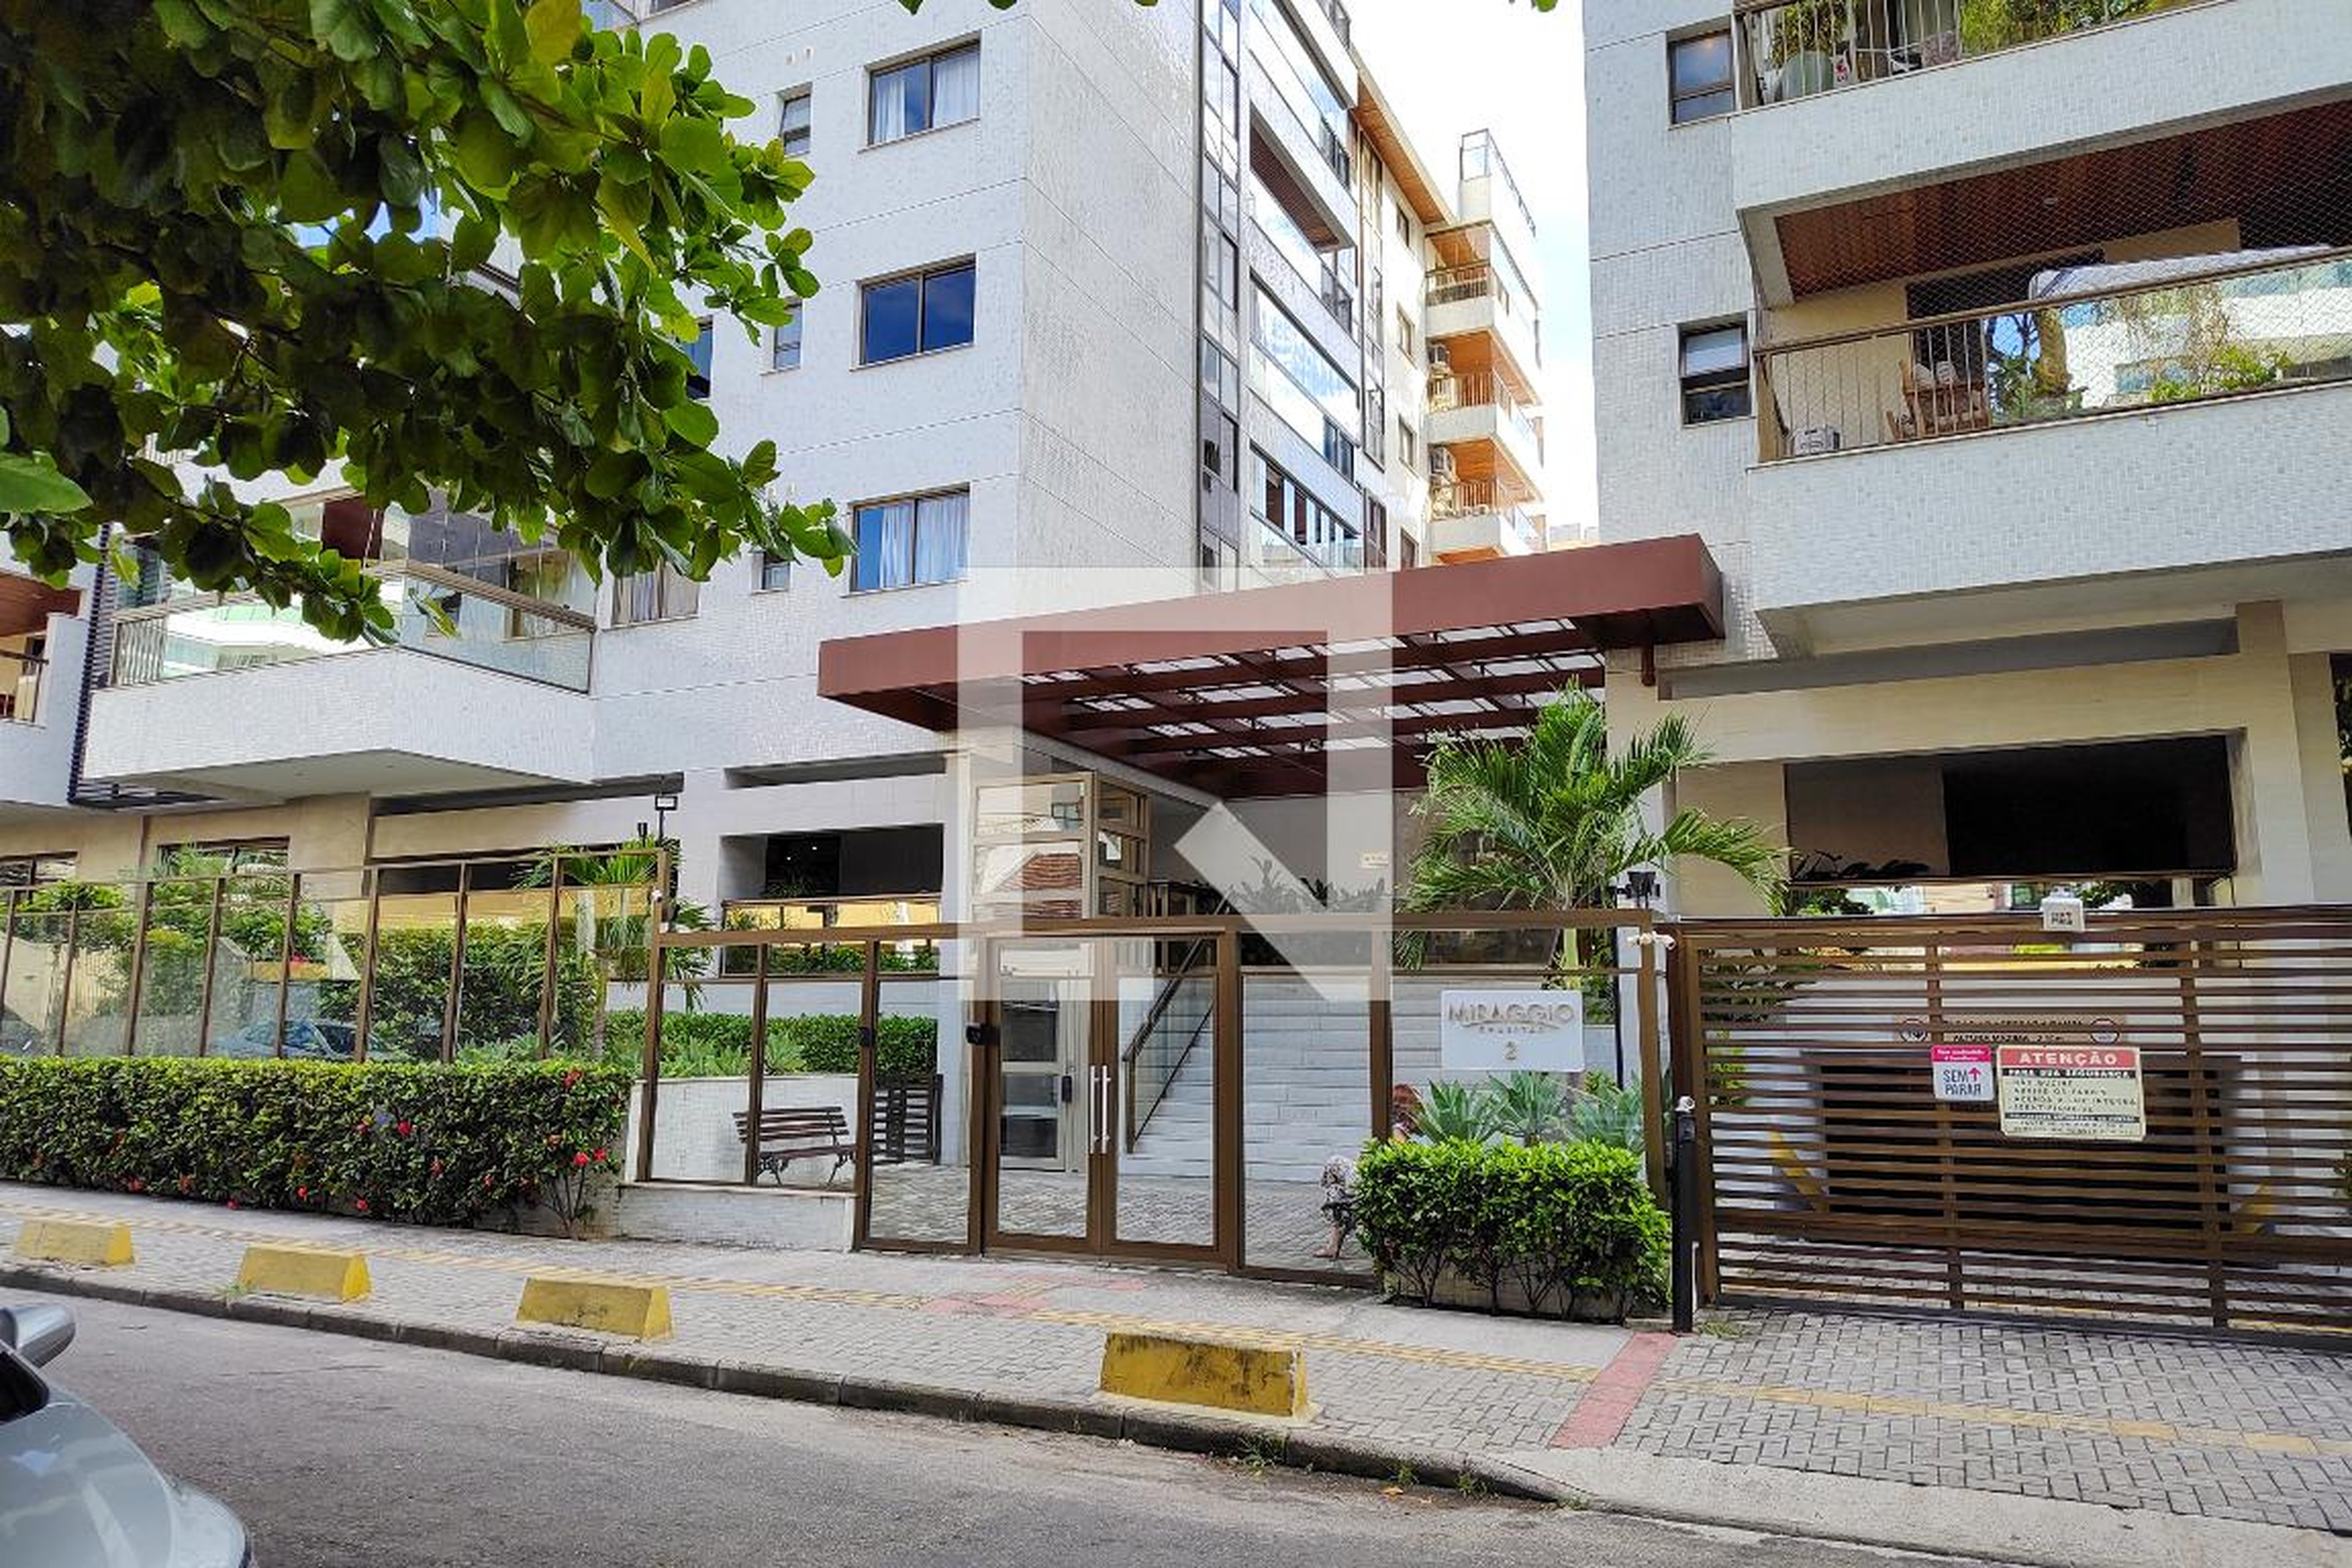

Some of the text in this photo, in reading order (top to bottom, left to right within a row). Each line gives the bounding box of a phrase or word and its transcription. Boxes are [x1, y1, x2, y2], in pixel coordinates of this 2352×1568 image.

[1449, 1000, 1574, 1023] MIRAGGIO
[2019, 1050, 2118, 1066] ATENÇÃO
[1943, 1069, 1969, 1082] SEM
[1945, 1083, 1981, 1095] PARAR
